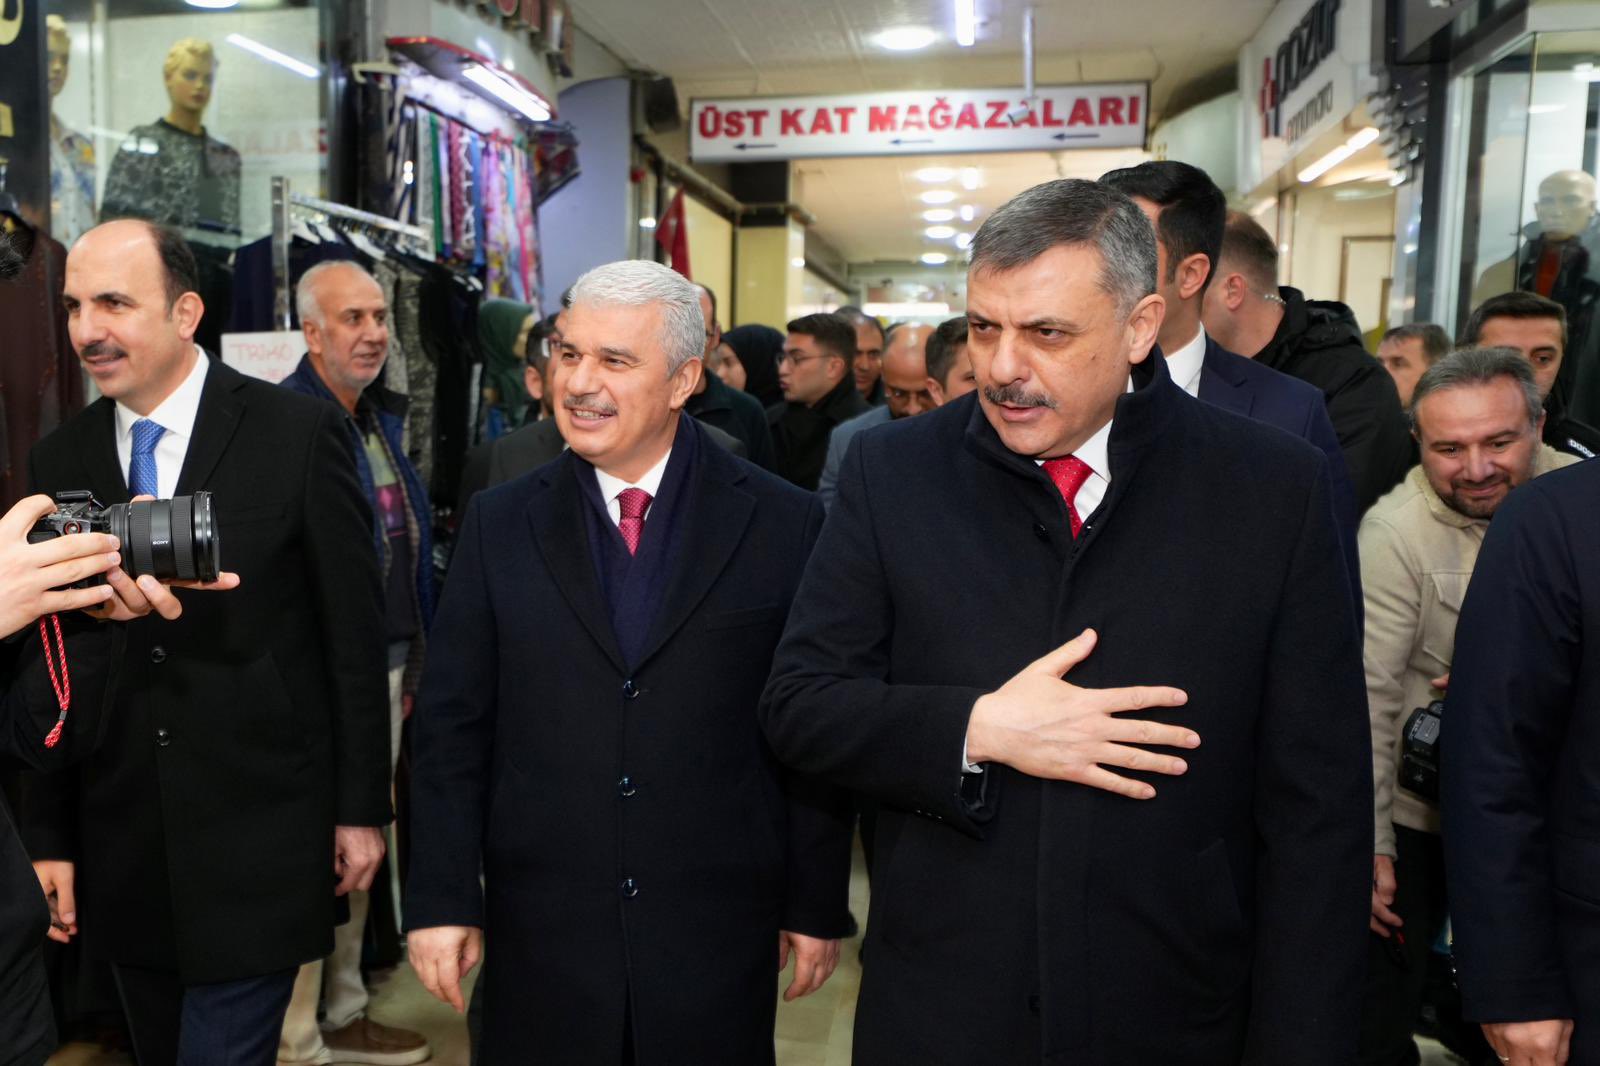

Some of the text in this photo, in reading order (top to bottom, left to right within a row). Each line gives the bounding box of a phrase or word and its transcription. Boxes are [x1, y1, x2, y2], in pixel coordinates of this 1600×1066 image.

[699, 97, 1141, 138] ÜST KAT MAĞAZALARI
